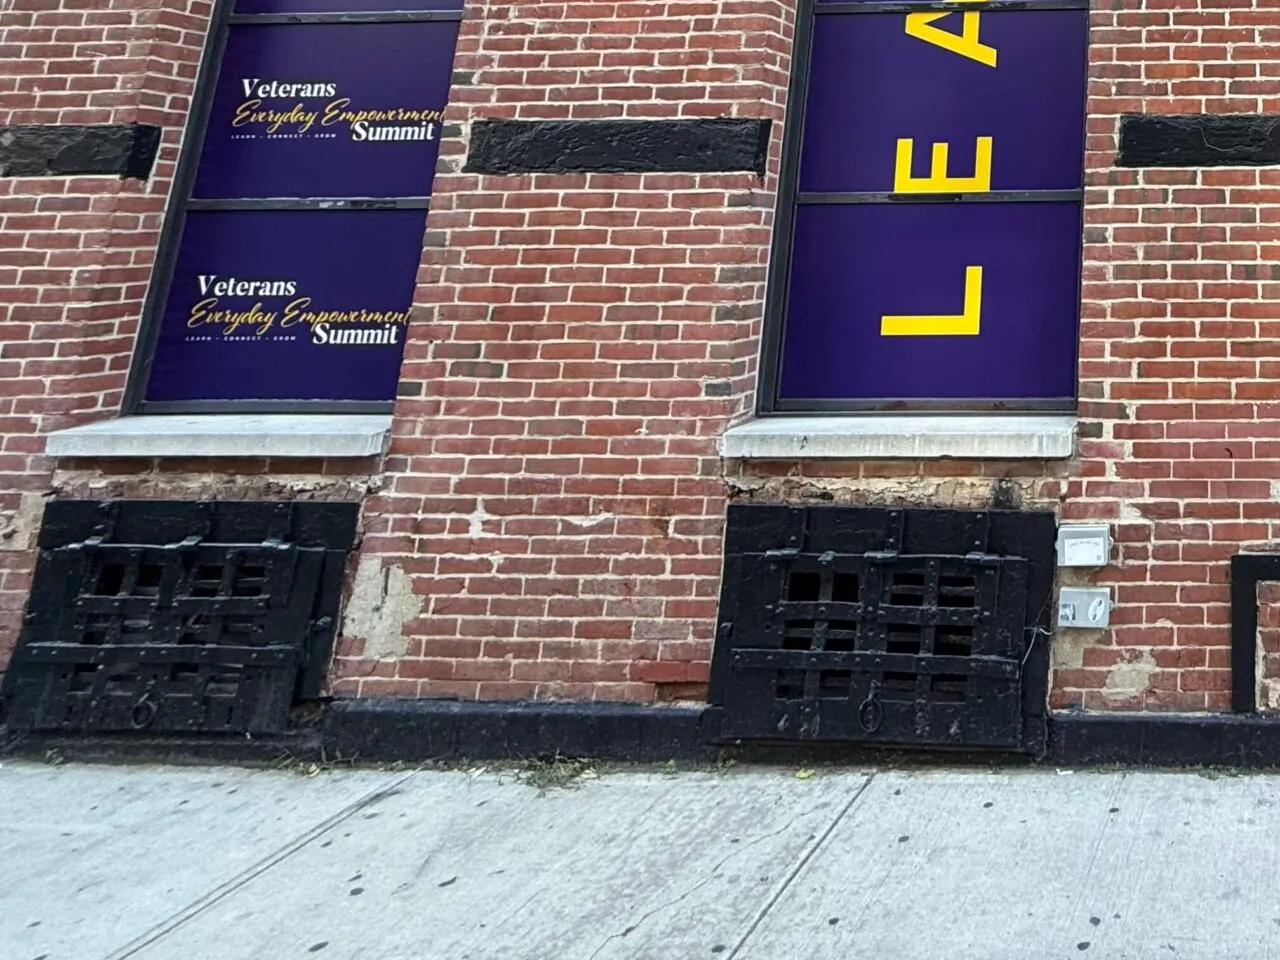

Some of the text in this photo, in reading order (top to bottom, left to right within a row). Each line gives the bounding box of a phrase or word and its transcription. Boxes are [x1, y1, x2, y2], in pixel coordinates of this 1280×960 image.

[242, 78, 337, 98] Veterans
[231, 99, 319, 134] Everyday
[352, 120, 435, 141] Summit
[197, 275, 297, 296] Veterans
[187, 297, 278, 335] Everyday
[312, 323, 399, 344] Summit
